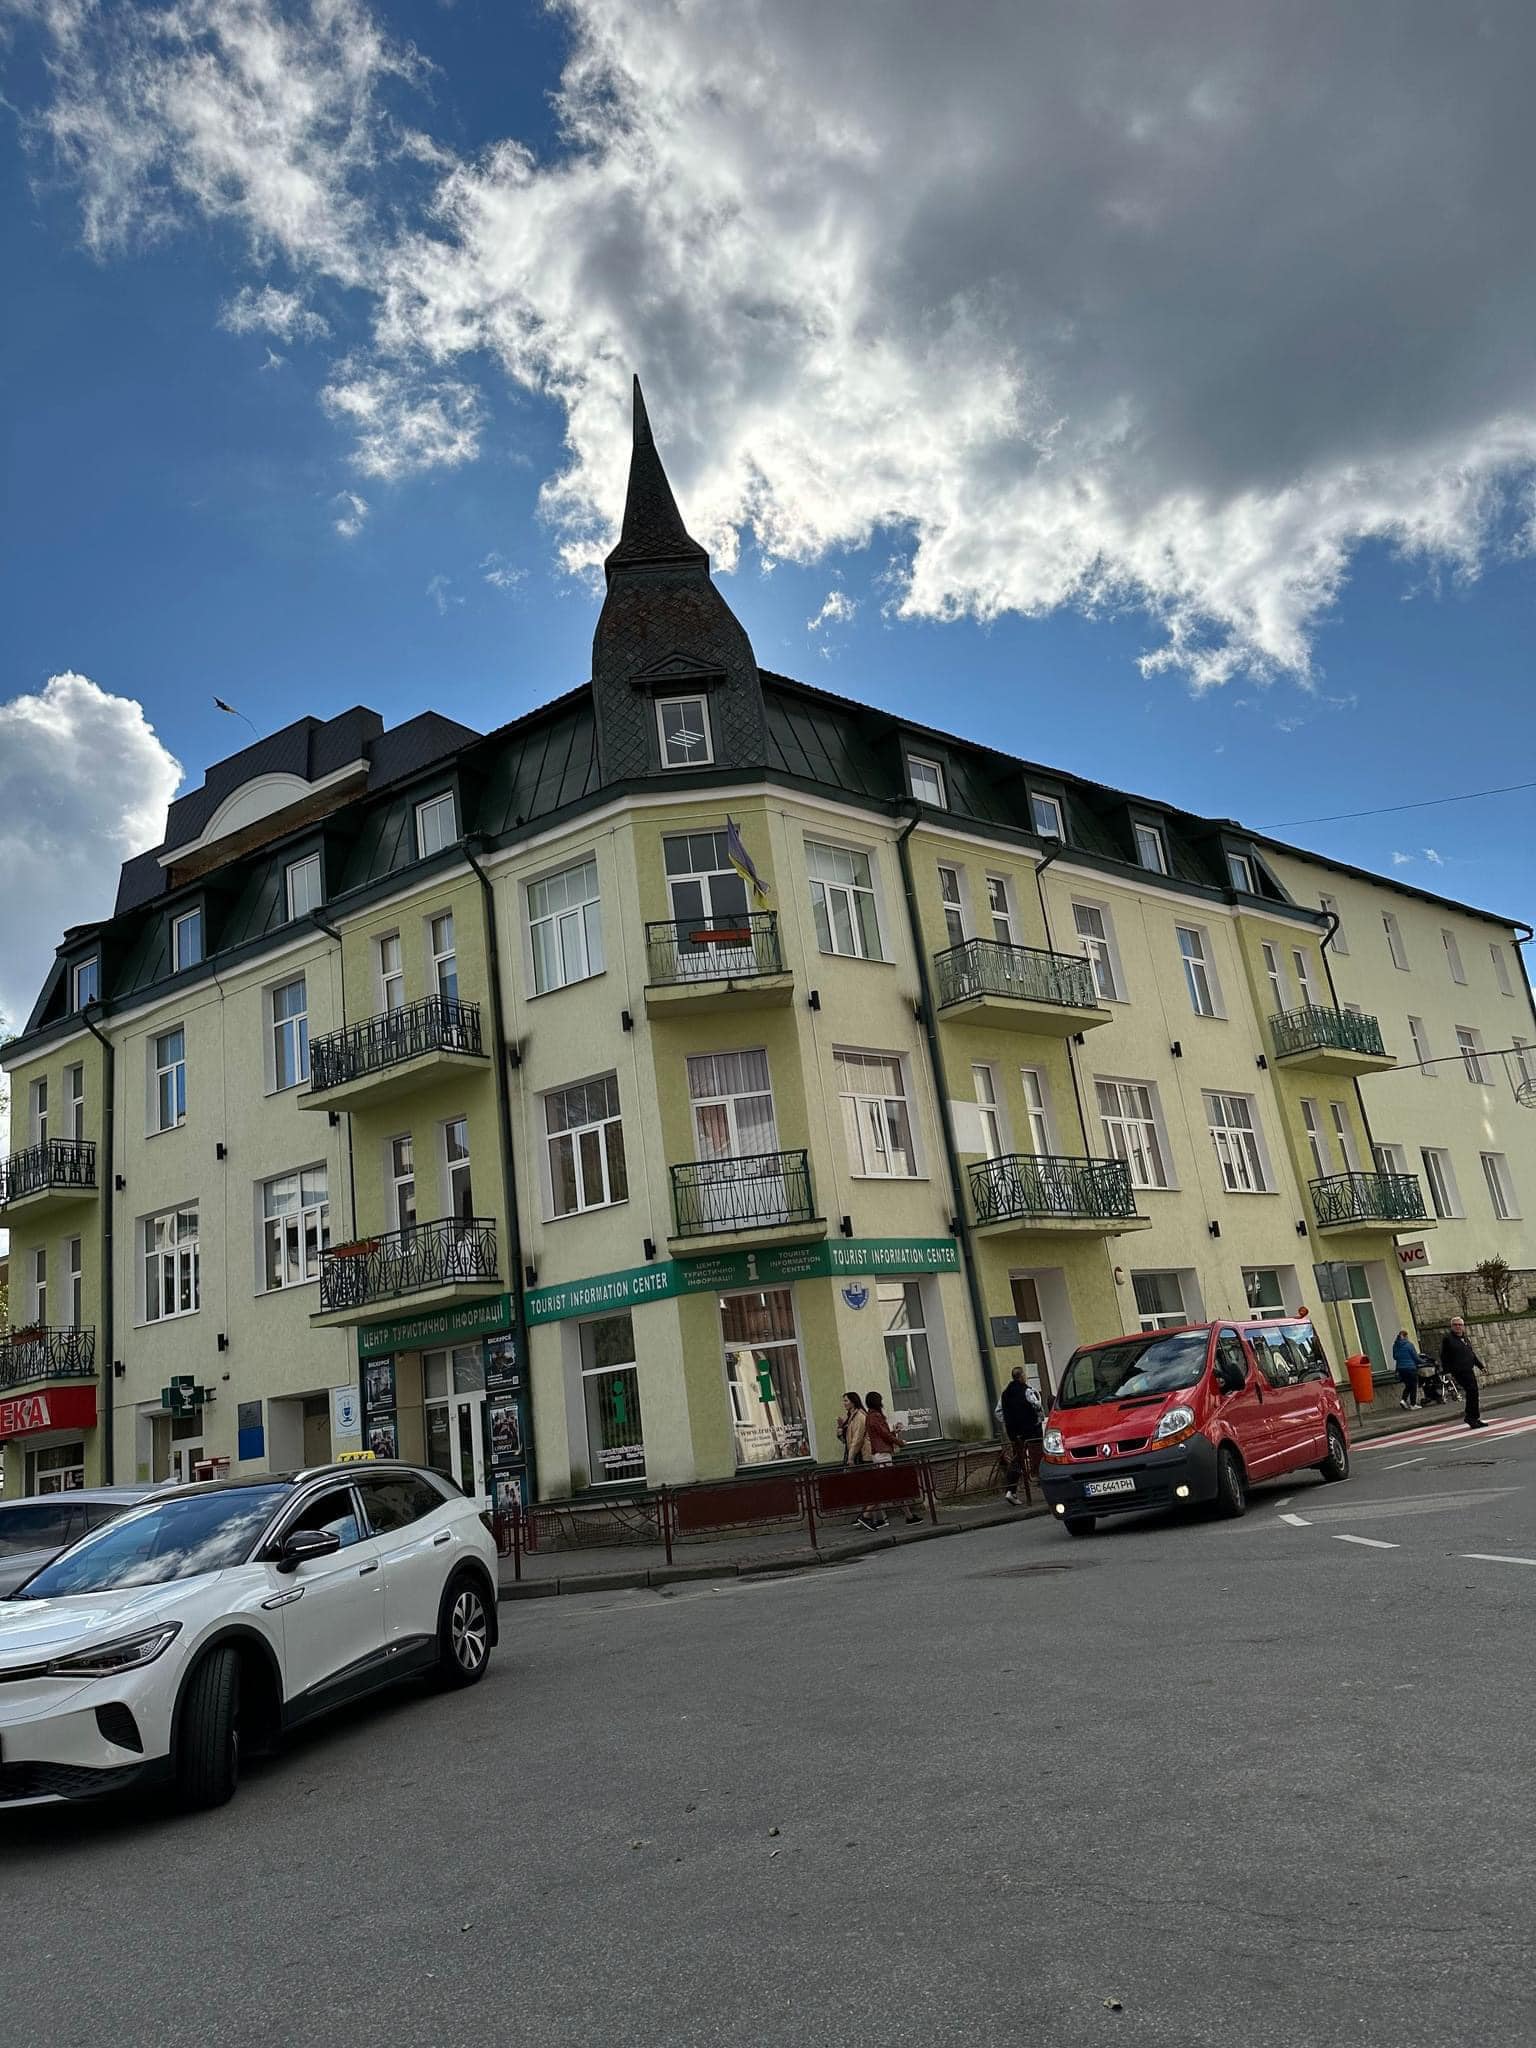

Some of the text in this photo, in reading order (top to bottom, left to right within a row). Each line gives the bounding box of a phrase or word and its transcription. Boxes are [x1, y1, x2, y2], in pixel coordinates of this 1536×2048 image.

[779, 1250, 810, 1258] TOURIST
[833, 1248, 956, 1265] TOURIST INFORMATION CENTER
[1398, 1248, 1425, 1263] WC
[696, 1260, 721, 1270] ЦЕНТР
[770, 1256, 821, 1267] INFORMATION
[782, 1264, 811, 1274] CENTER
[531, 1272, 668, 1315] TOURIST INFORMATION CENTER
[363, 1302, 504, 1348] ЦЕНТР ТУРИСТИЧНОЇ ІНФОРМАЦІЇ
